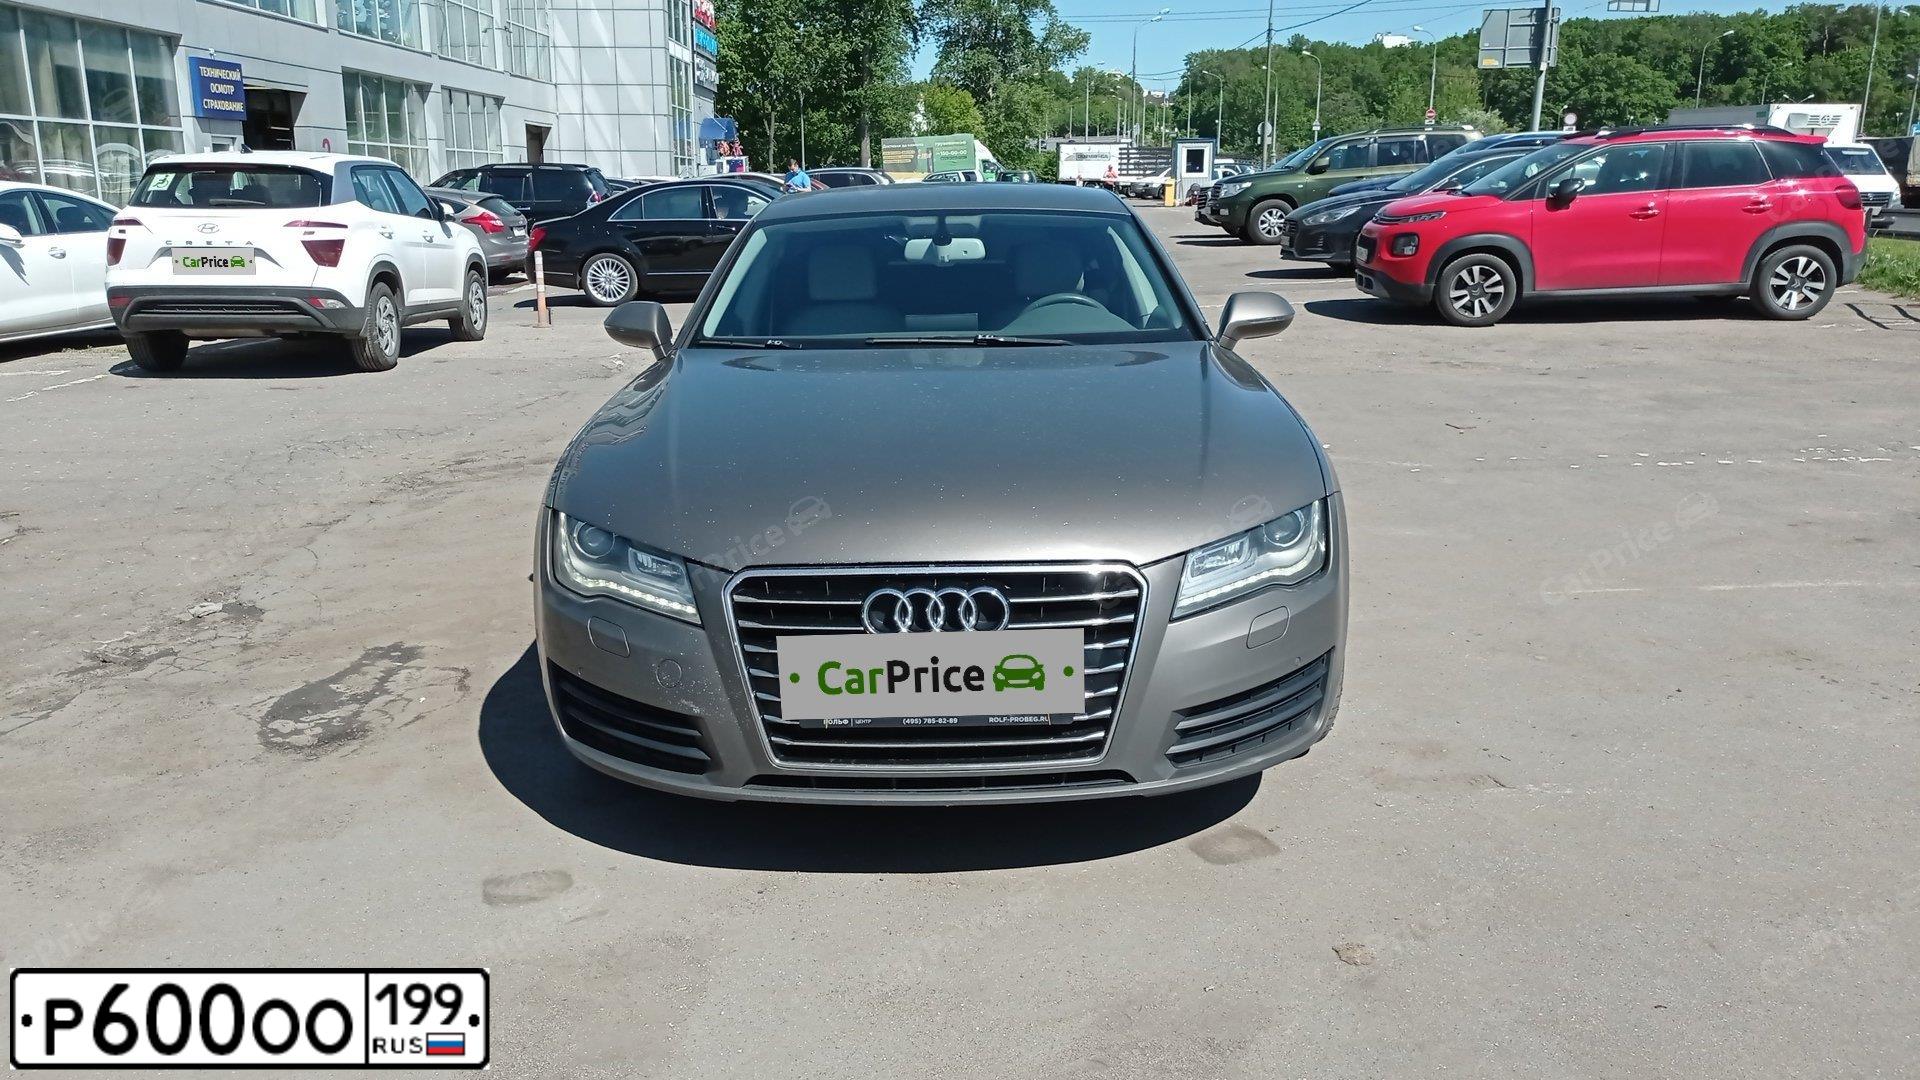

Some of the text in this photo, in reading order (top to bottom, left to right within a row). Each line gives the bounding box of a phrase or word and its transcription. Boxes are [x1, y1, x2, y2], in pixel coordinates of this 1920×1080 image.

[199, 66, 242, 81] ТЕХНИЧЕСКИЙ
[210, 83, 235, 95] ОСМОТР
[203, 98, 244, 112] СТРАХОВАНИЕ
